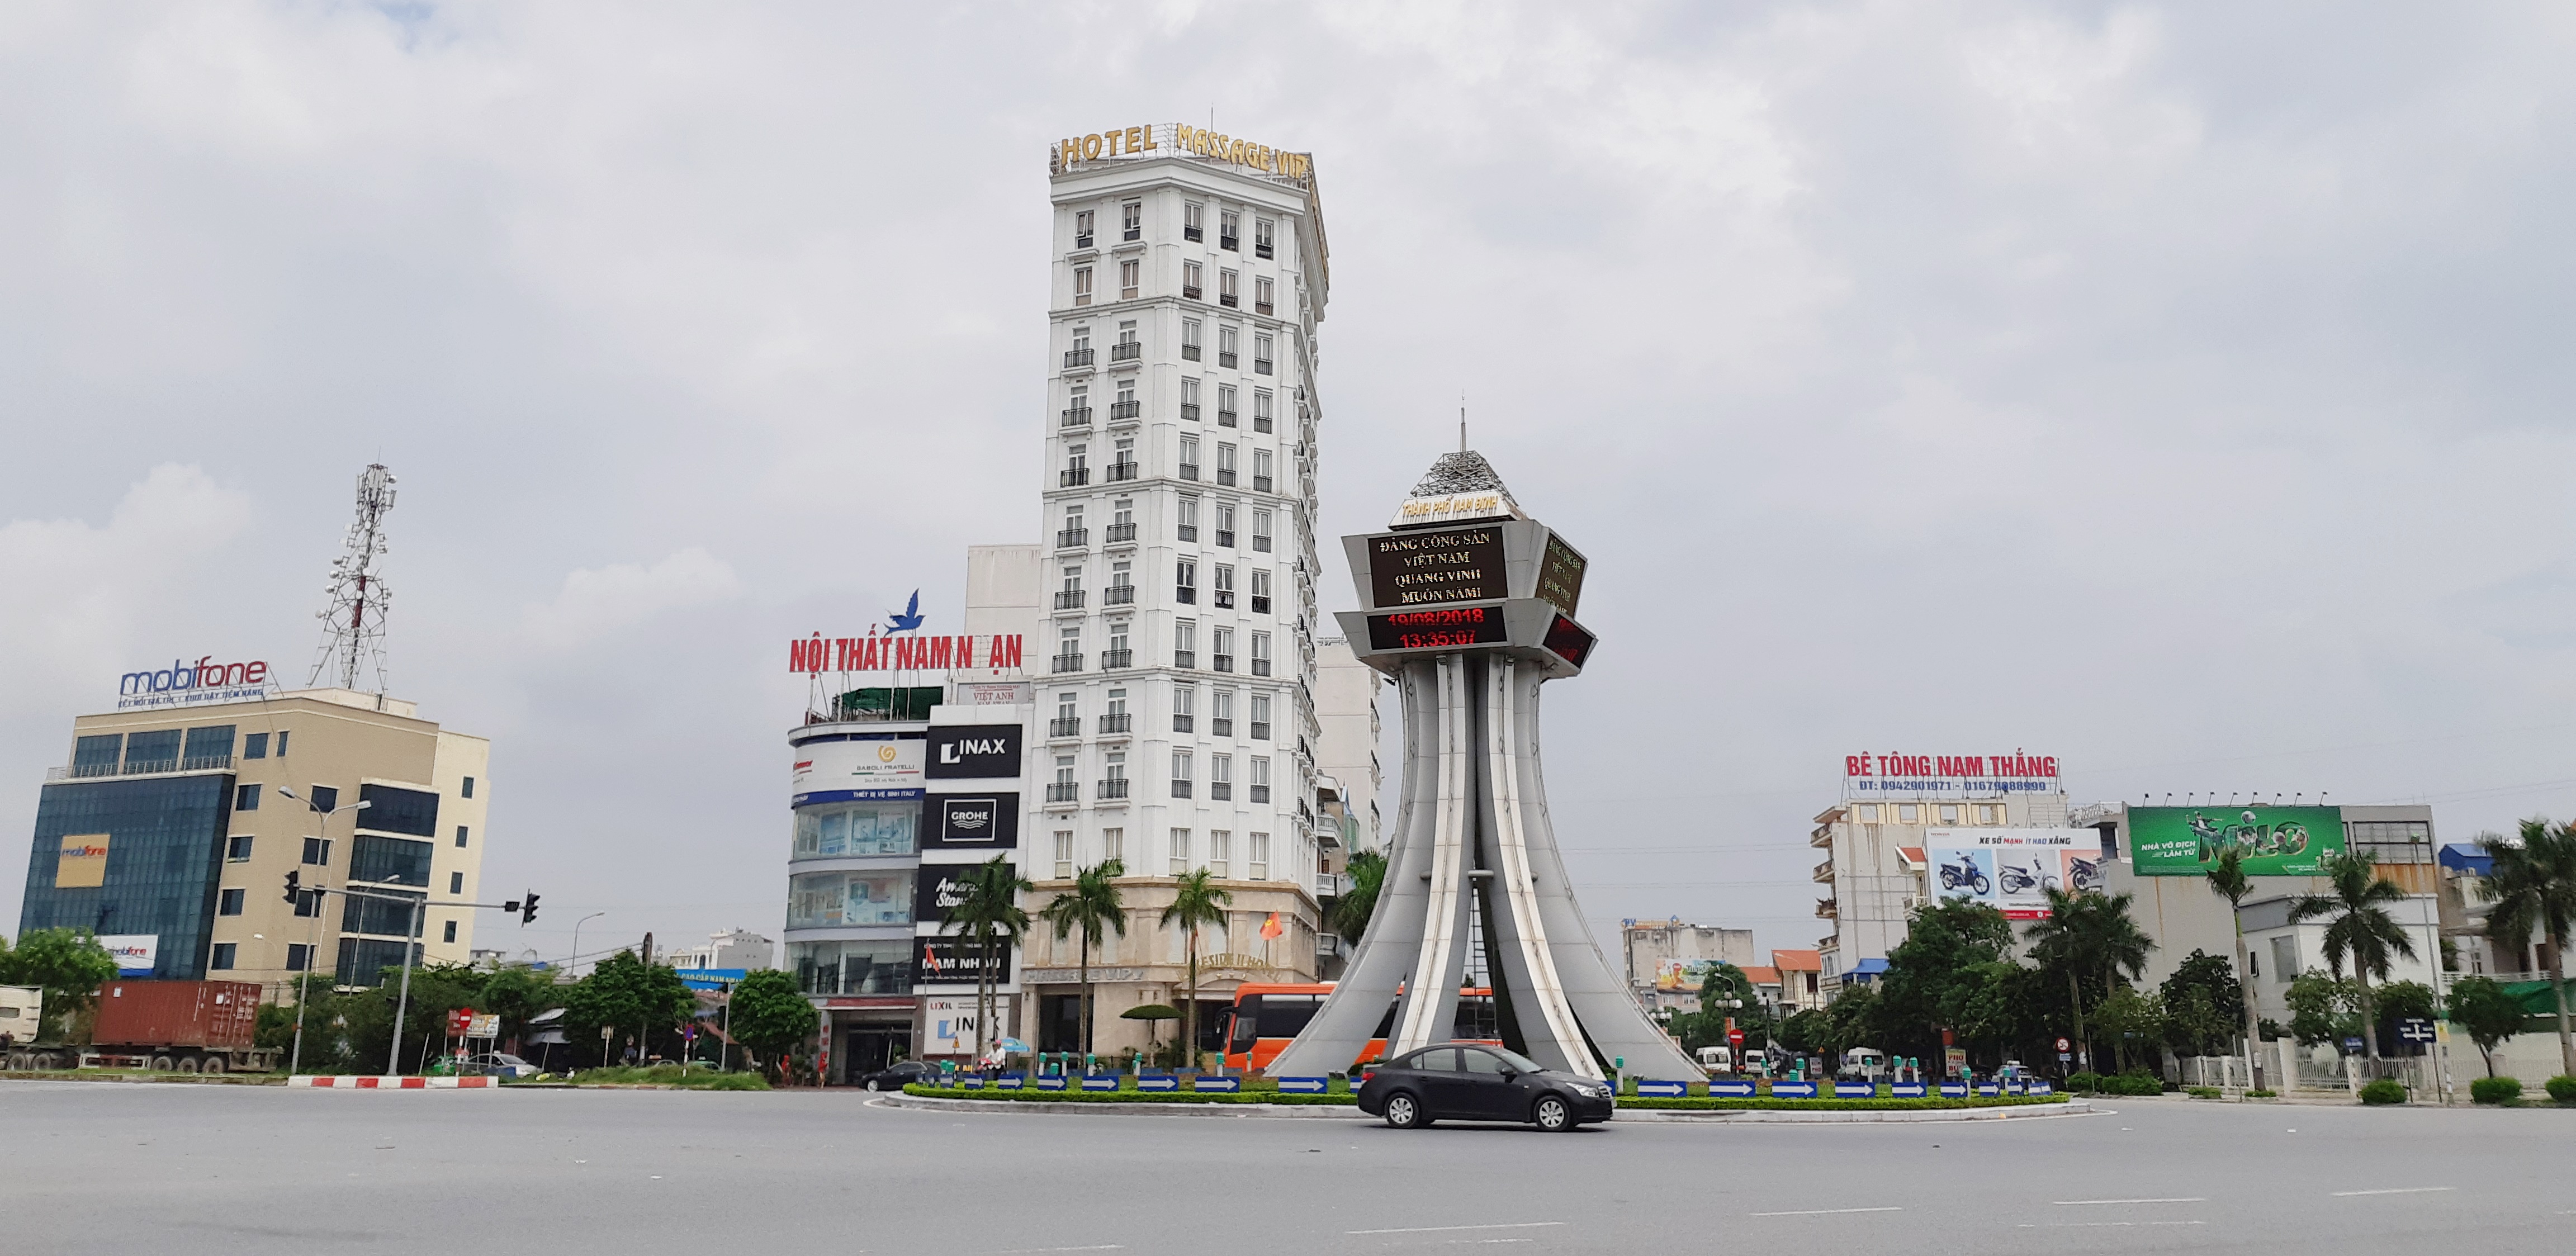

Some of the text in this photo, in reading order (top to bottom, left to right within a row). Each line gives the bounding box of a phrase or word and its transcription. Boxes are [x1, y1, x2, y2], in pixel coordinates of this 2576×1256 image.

[1062, 122, 1307, 179] HOTEL MASSAGE VIP
[1403, 500, 1431, 516] THÀNH
[1453, 497, 1474, 511] NAM
[1404, 551, 1471, 568] VIỆT NAM
[1395, 569, 1481, 587] QUANG VINH
[1388, 608, 1485, 626] 19/08/2018
[1400, 630, 1476, 648] 13:35:07
[789, 631, 831, 680] NỘI
[836, 623, 892, 671] THẤT
[896, 636, 952, 670] NAM
[120, 655, 267, 695] mobifone
[973, 691, 993, 701] VIỆT
[959, 738, 1005, 755] INAX
[1846, 747, 2056, 777] BÊ TÔNG NAM THẮNG
[1881, 781, 1951, 790] 0942901971
[951, 812, 988, 820] GROHE
[1992, 835, 2004, 844] SỐ
[2004, 837, 2023, 846] MẠNH
[2048, 835, 2071, 845] XĂNG
[2141, 842, 2160, 851] NHÀ
[2175, 841, 2196, 849] ĐỊCH
[930, 1001, 952, 1010] LIXIL
